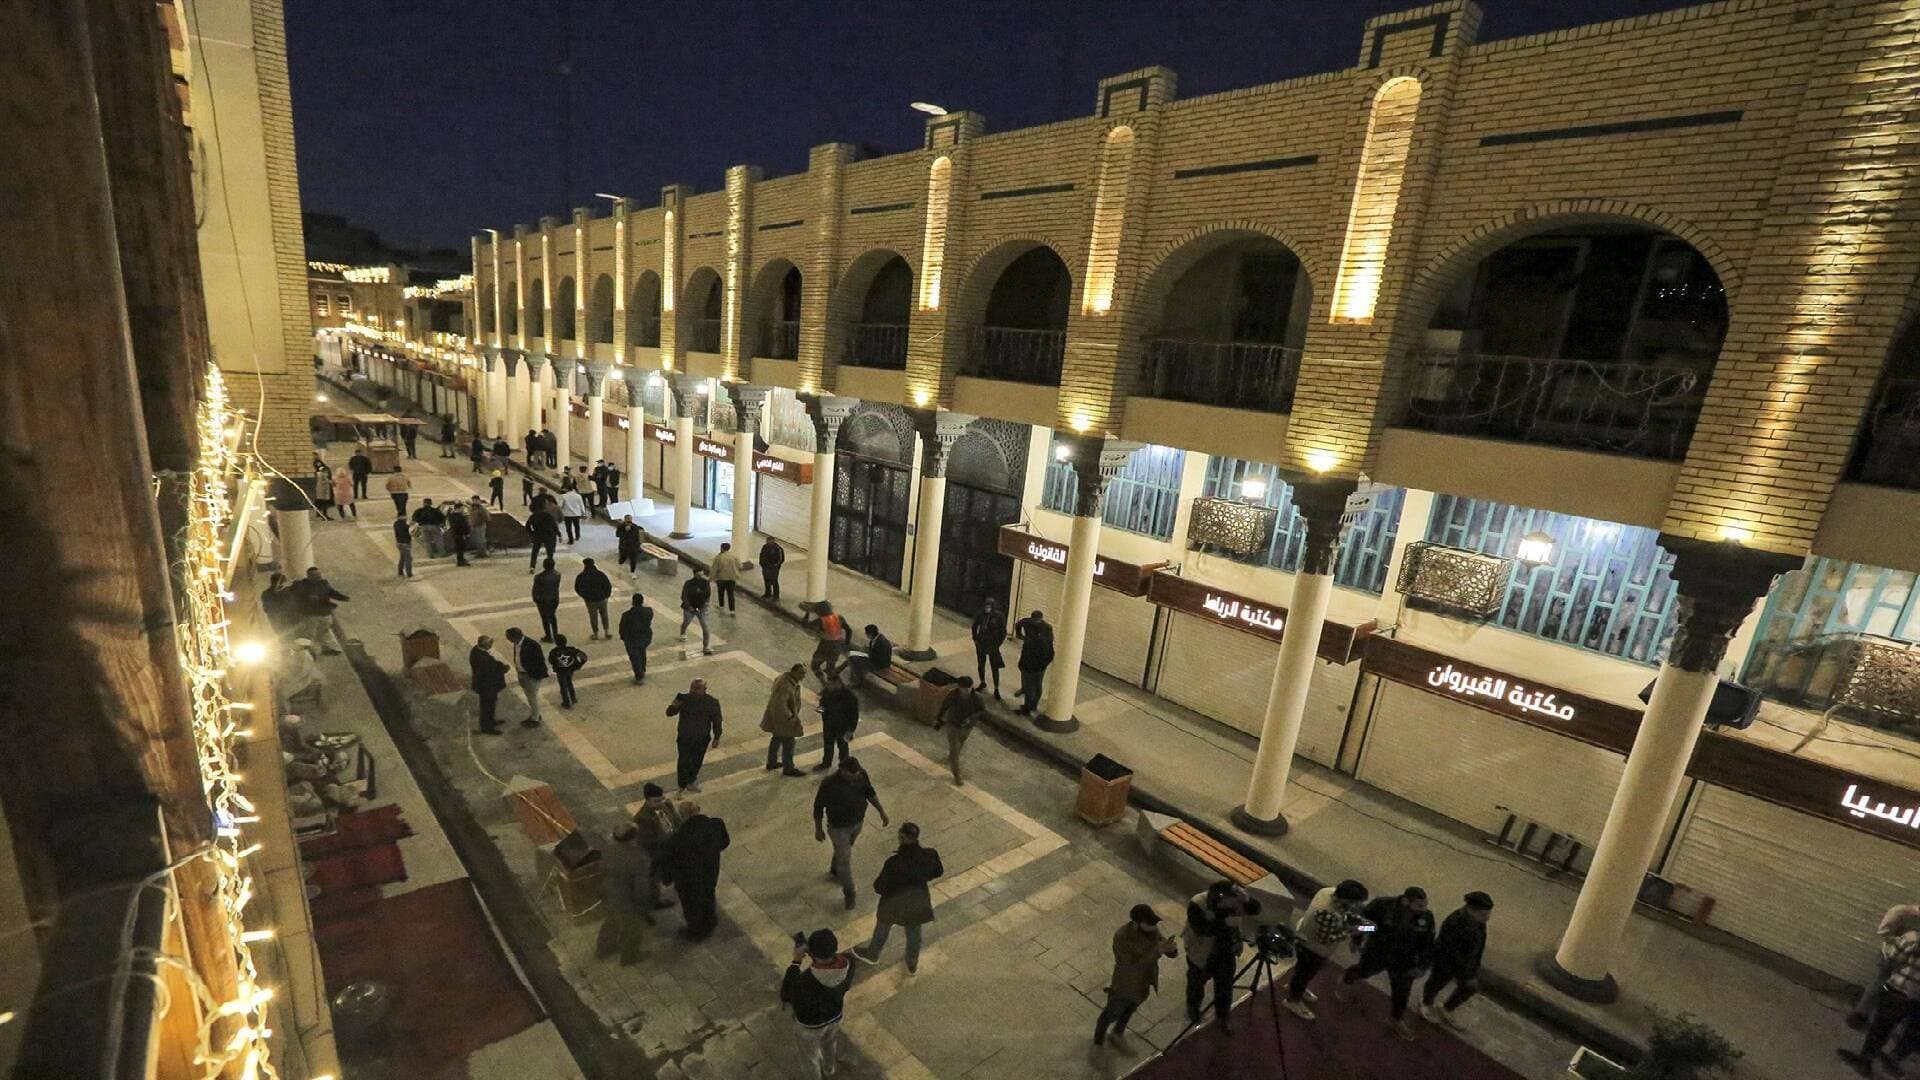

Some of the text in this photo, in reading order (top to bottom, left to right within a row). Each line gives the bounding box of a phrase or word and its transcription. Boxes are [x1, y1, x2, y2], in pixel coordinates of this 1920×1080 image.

[1240, 604, 1283, 630] مكتبة
[1428, 664, 1575, 721] مكتبة القيروان
